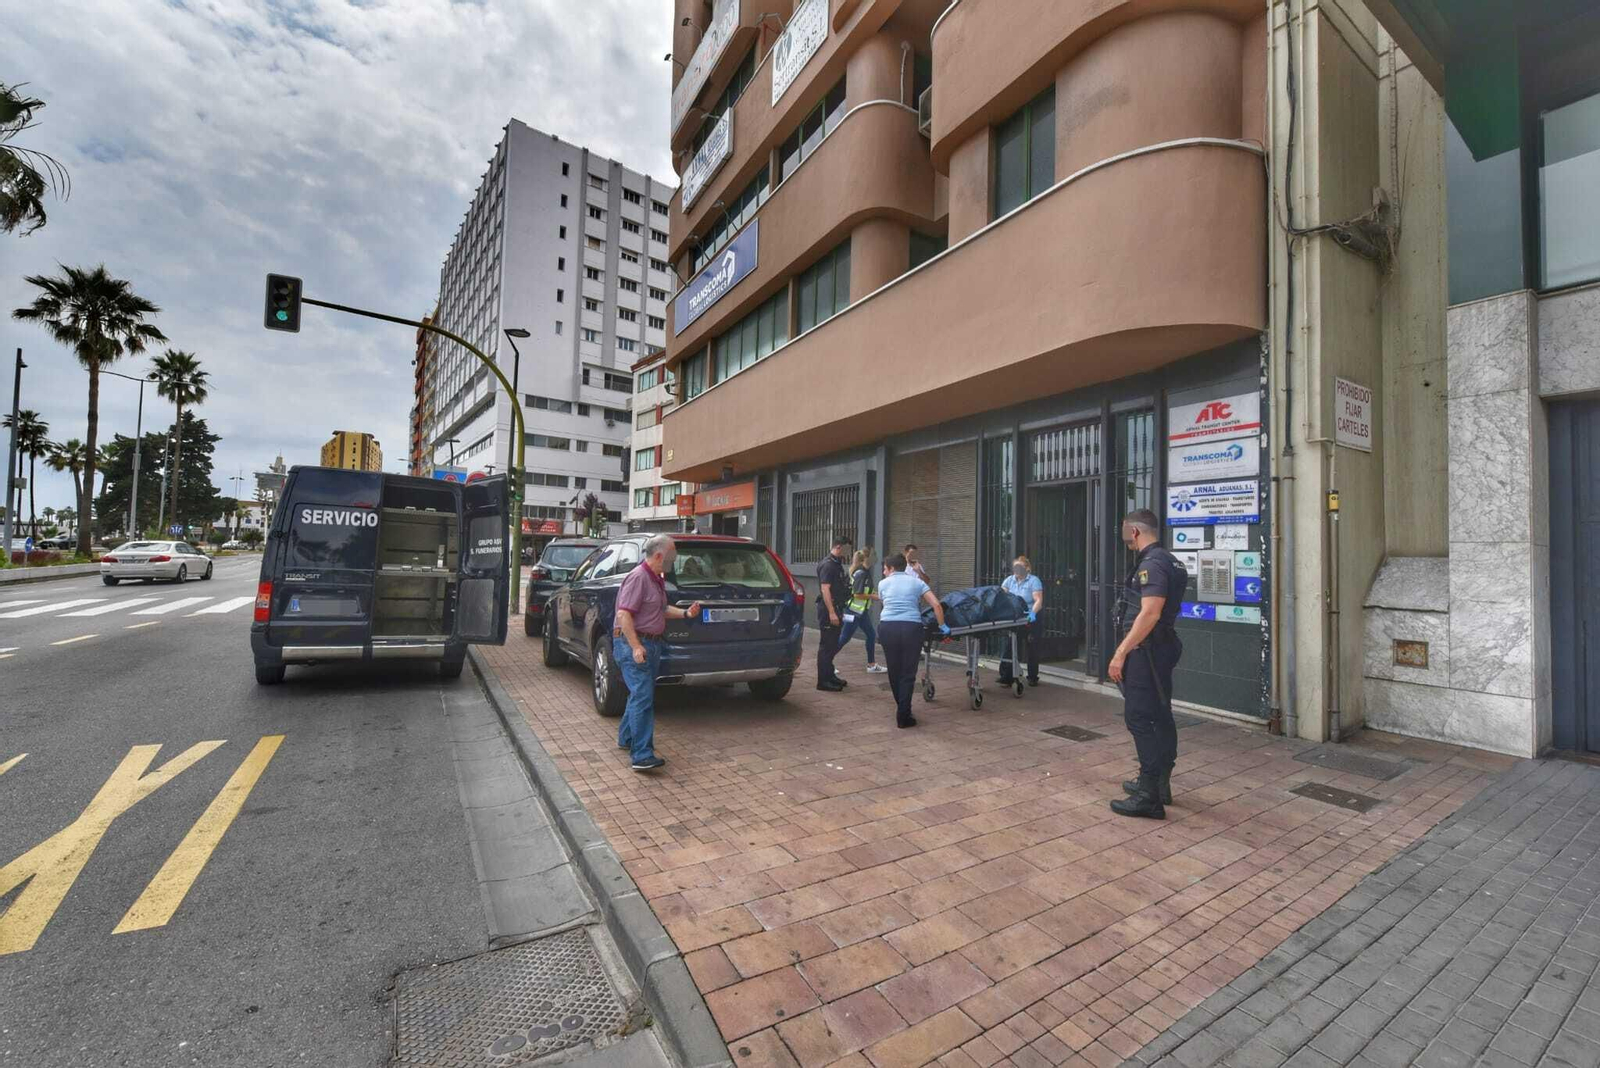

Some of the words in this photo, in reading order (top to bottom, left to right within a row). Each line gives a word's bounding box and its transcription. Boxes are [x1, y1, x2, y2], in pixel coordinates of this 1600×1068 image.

[689, 267, 727, 310] TRANSCOMA
[1337, 380, 1370, 404] PROHIBIDO
[1195, 401, 1232, 424] ATC
[1345, 401, 1362, 419] FIJAR
[1337, 416, 1369, 438] CARTELES
[1182, 451, 1233, 462] TRANSCOMA
[1194, 486, 1216, 494] ARNAL
[301, 509, 378, 527] SERVICIO
